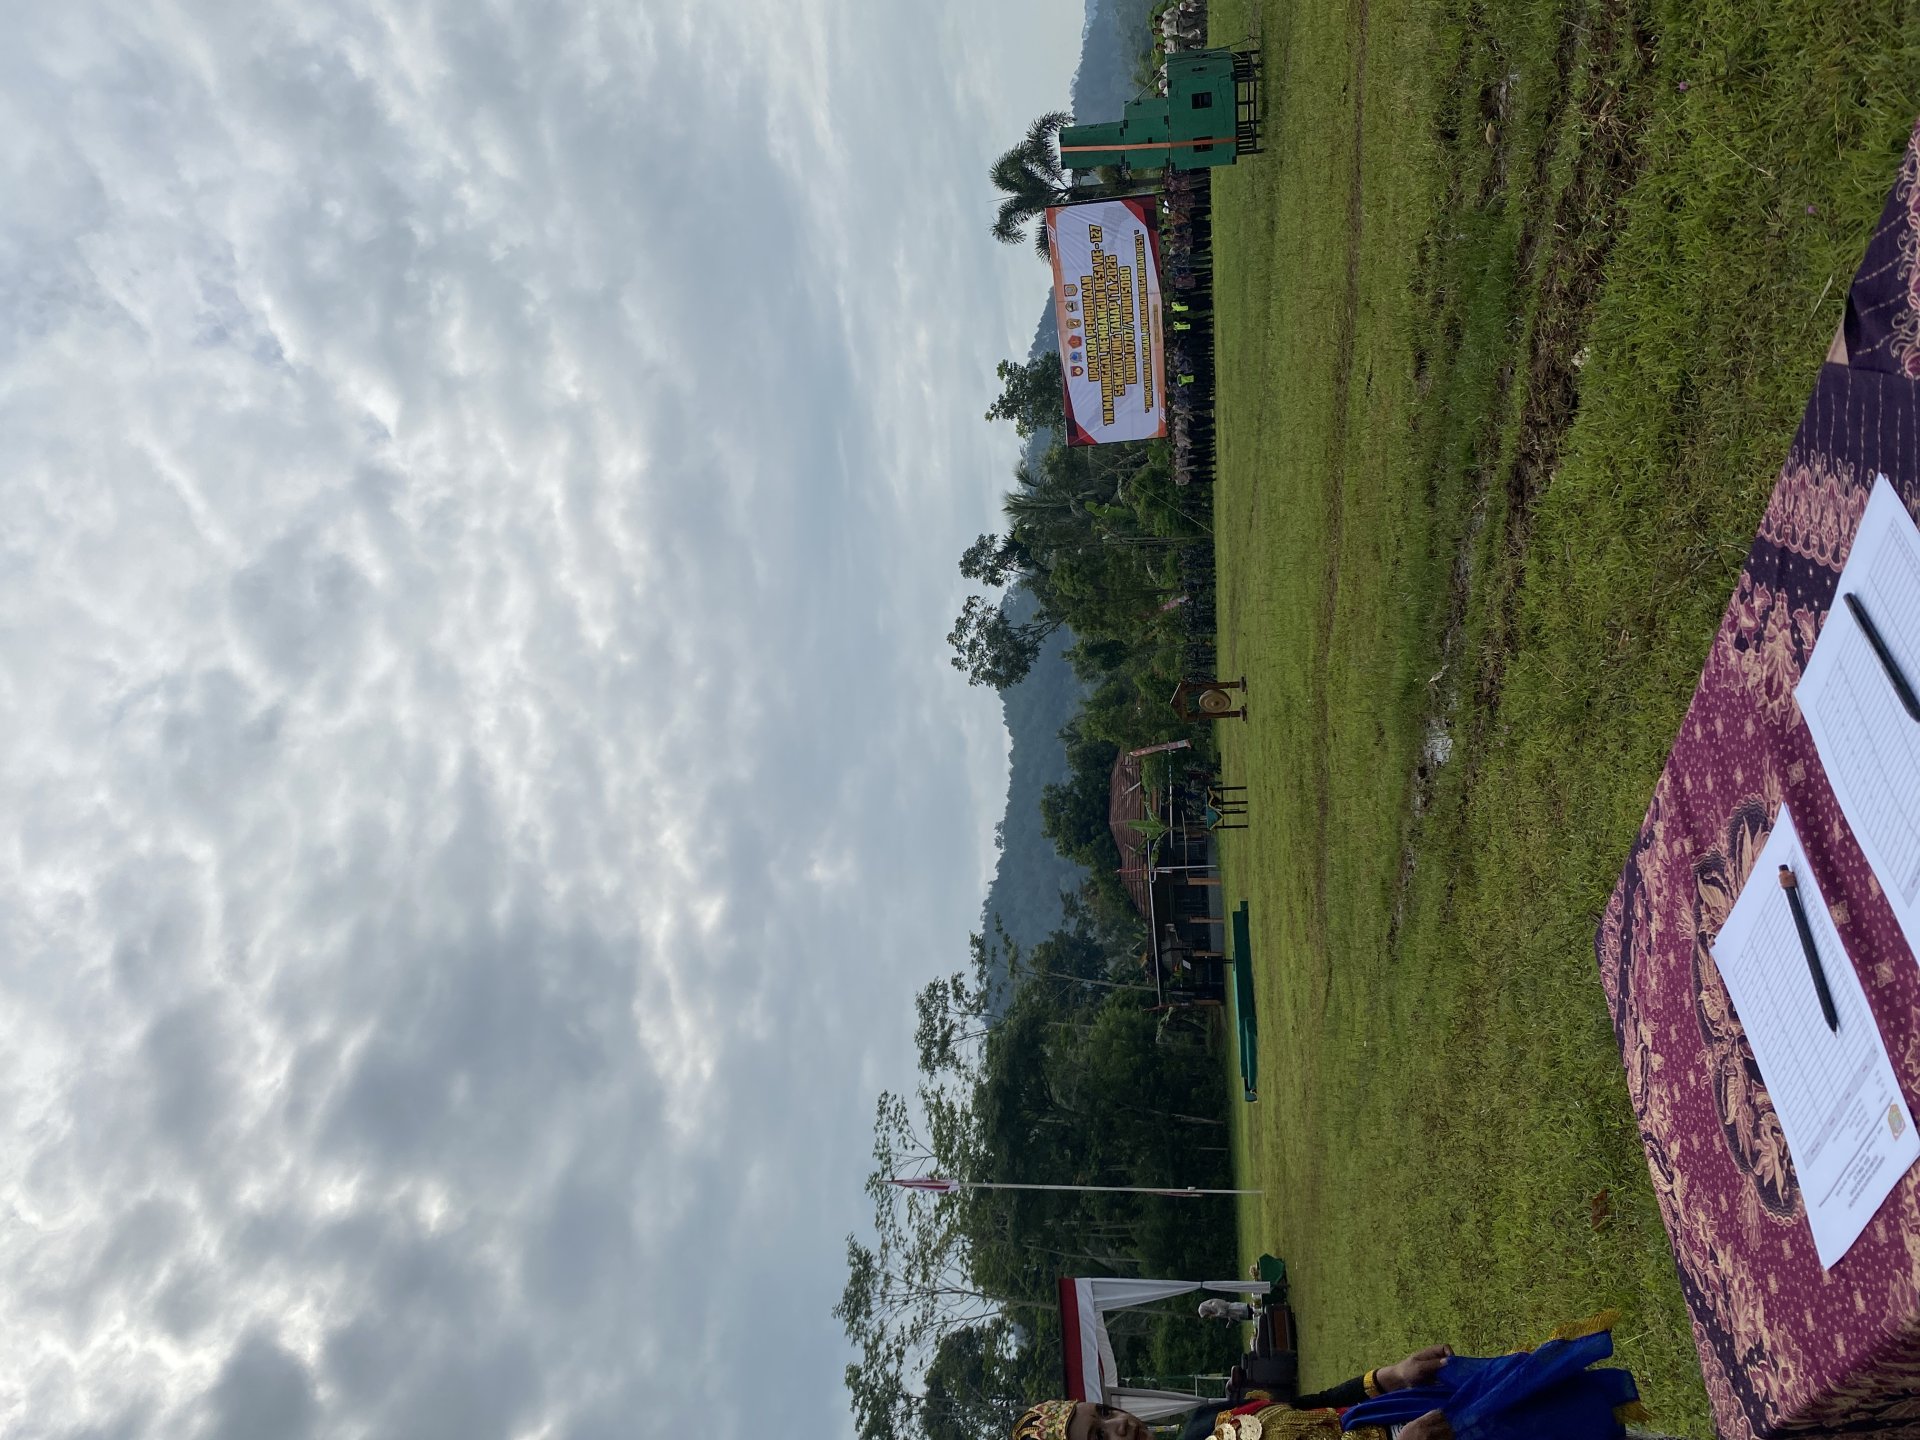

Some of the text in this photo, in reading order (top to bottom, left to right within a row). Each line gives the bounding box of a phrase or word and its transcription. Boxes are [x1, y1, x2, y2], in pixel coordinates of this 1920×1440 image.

[1089, 224, 1102, 243] 127
[1091, 250, 1103, 264] KE
[1105, 255, 1117, 282] 2026
[1136, 252, 1146, 269] DARI
[1093, 264, 1106, 290] DESA
[1107, 282, 1119, 295] TA
[1137, 269, 1147, 292] NEGERI
[1096, 291, 1110, 353] MEMBANGUN
[1109, 301, 1121, 333] TAHAP
[1139, 293, 1149, 333] MEMBANGUN
[1081, 275, 1099, 382] UPACARA PEMBUKAAN
[1111, 334, 1125, 397] SENGKUYUNG
[1124, 353, 1137, 384] KODIM
[1143, 363, 1152, 391] SATUKAN
[1101, 354, 1113, 409] MANUNGGAL
[1103, 410, 1114, 426] TNI
